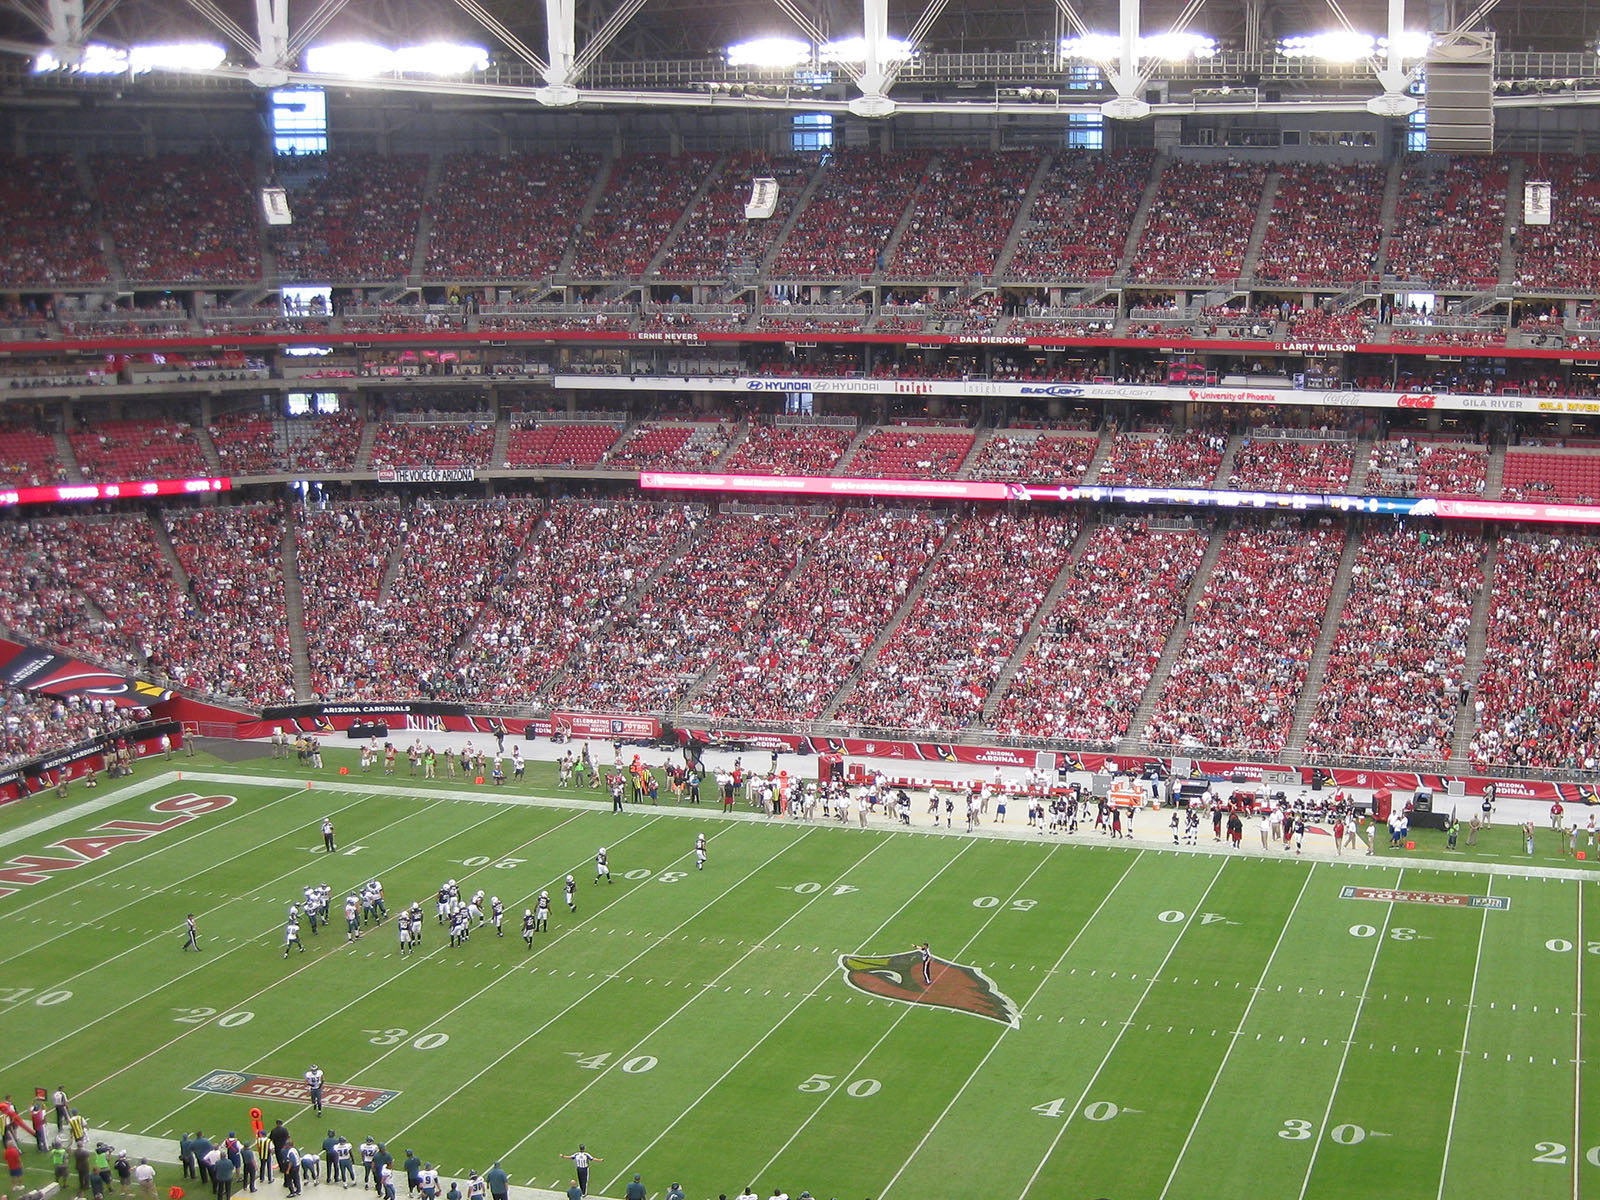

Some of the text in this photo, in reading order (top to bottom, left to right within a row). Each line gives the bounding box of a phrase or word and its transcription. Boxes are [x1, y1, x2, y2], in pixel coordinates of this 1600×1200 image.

[981, 336, 1026, 344] DIERDORF
[765, 382, 812, 390] HYUNDAI
[832, 382, 879, 391] HYUNDAI
[1200, 391, 1275, 401] University of Phoenix
[1463, 399, 1523, 409] GILA RIVER
[1538, 402, 1599, 413] GILA RIVER
[396, 470, 474, 481] THE VOICE OF ARIZONA
[976, 755, 1024, 764] CARDINALS
[1483, 787, 1536, 796] CRDINALS
[0, 793, 238, 897] NALS
[972, 896, 1038, 911] 50
[1158, 910, 1226, 925] 40
[1348, 924, 1416, 940] 30
[173, 1008, 255, 1028] 20
[369, 1028, 450, 1050] 30
[576, 1052, 658, 1073] 40
[798, 1074, 882, 1097] 50
[1031, 1098, 1118, 1120] 40
[1278, 1119, 1366, 1144] 30
[425, 1176, 431, 1184] 9
